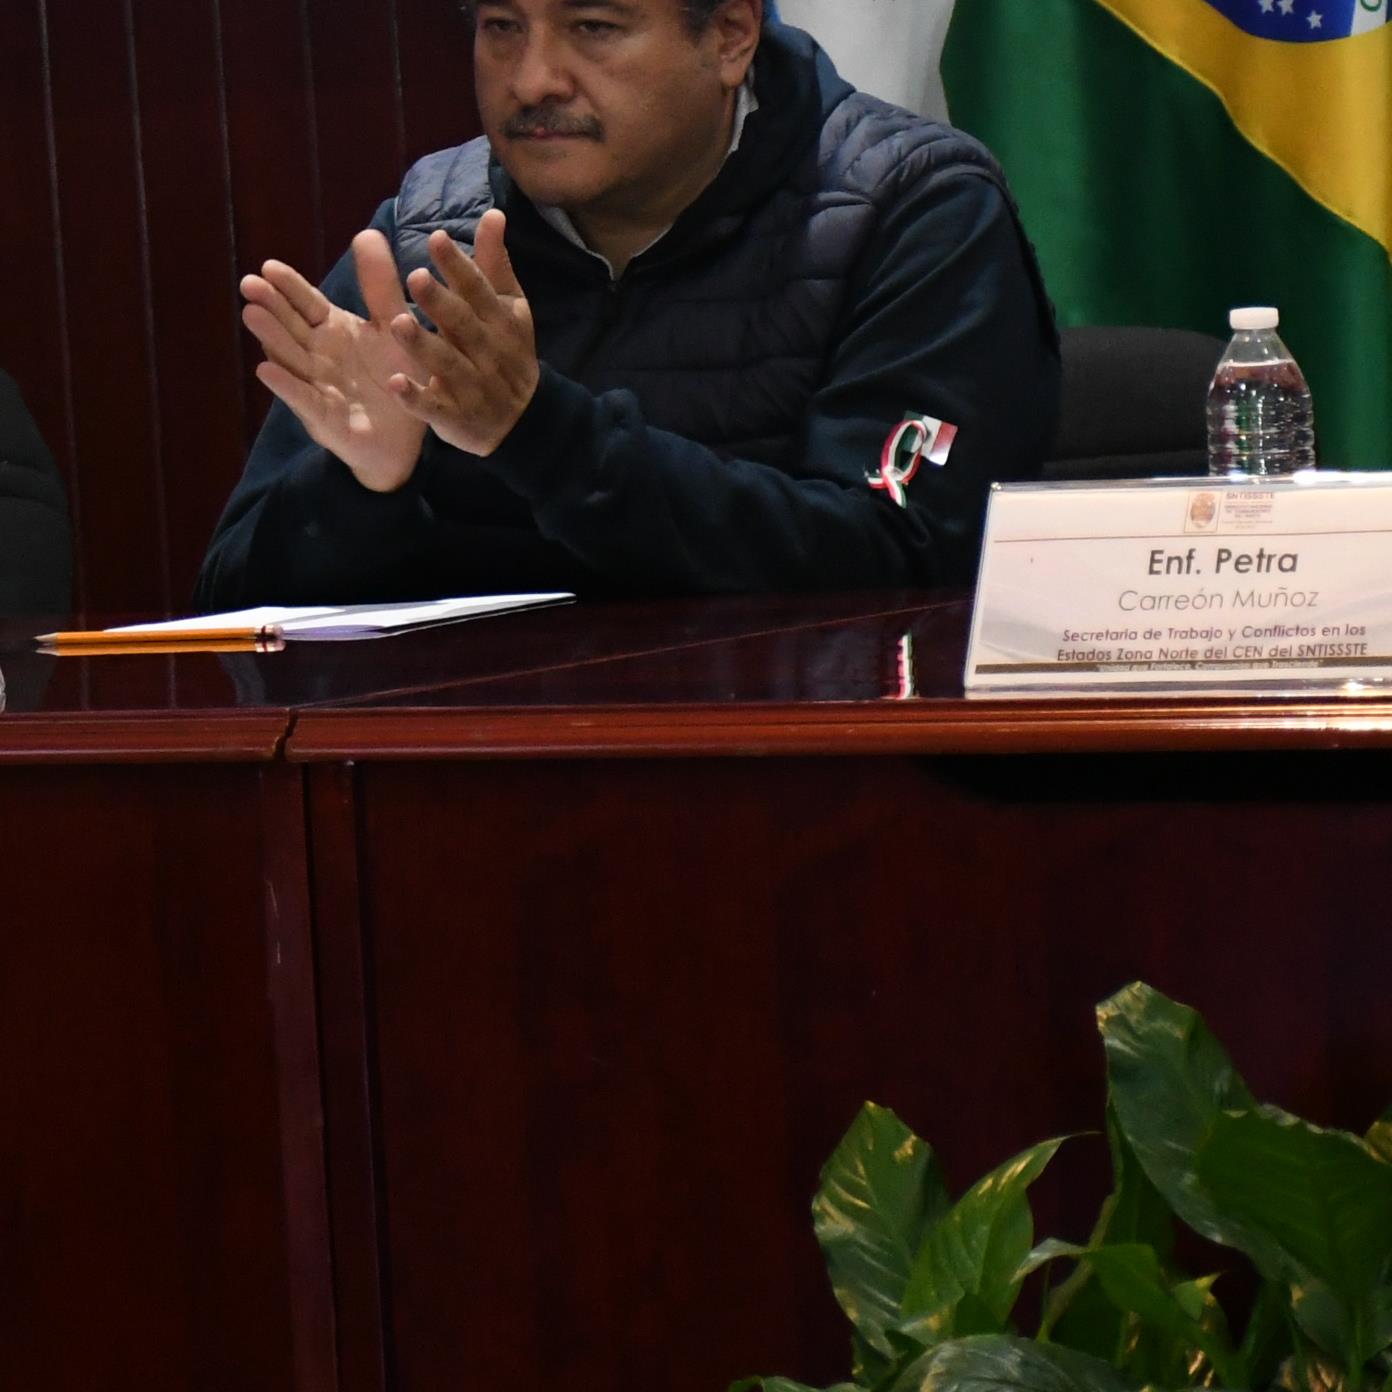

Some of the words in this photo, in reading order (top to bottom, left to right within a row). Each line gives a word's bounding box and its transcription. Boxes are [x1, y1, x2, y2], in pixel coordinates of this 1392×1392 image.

[1148, 549, 1201, 576] Enf.
[1216, 548, 1298, 574] Petra
[1118, 588, 1224, 612] Carreón
[1232, 587, 1319, 609] Muñoz
[1063, 629, 1138, 642] Secretaria
[1143, 629, 1162, 640] de
[1168, 627, 1223, 641] Trabajo
[1227, 630, 1235, 641] y
[1242, 626, 1316, 639] Conflictos
[1321, 627, 1341, 637] en
[1345, 624, 1366, 637] los
[1057, 648, 1112, 661] Estados
[1117, 648, 1155, 661] Zona
[1159, 647, 1199, 660] Norte
[1204, 646, 1227, 659] del
[1233, 646, 1263, 658] CEN
[1268, 644, 1292, 657] del
[1297, 643, 1368, 656] SNTISSSTE
